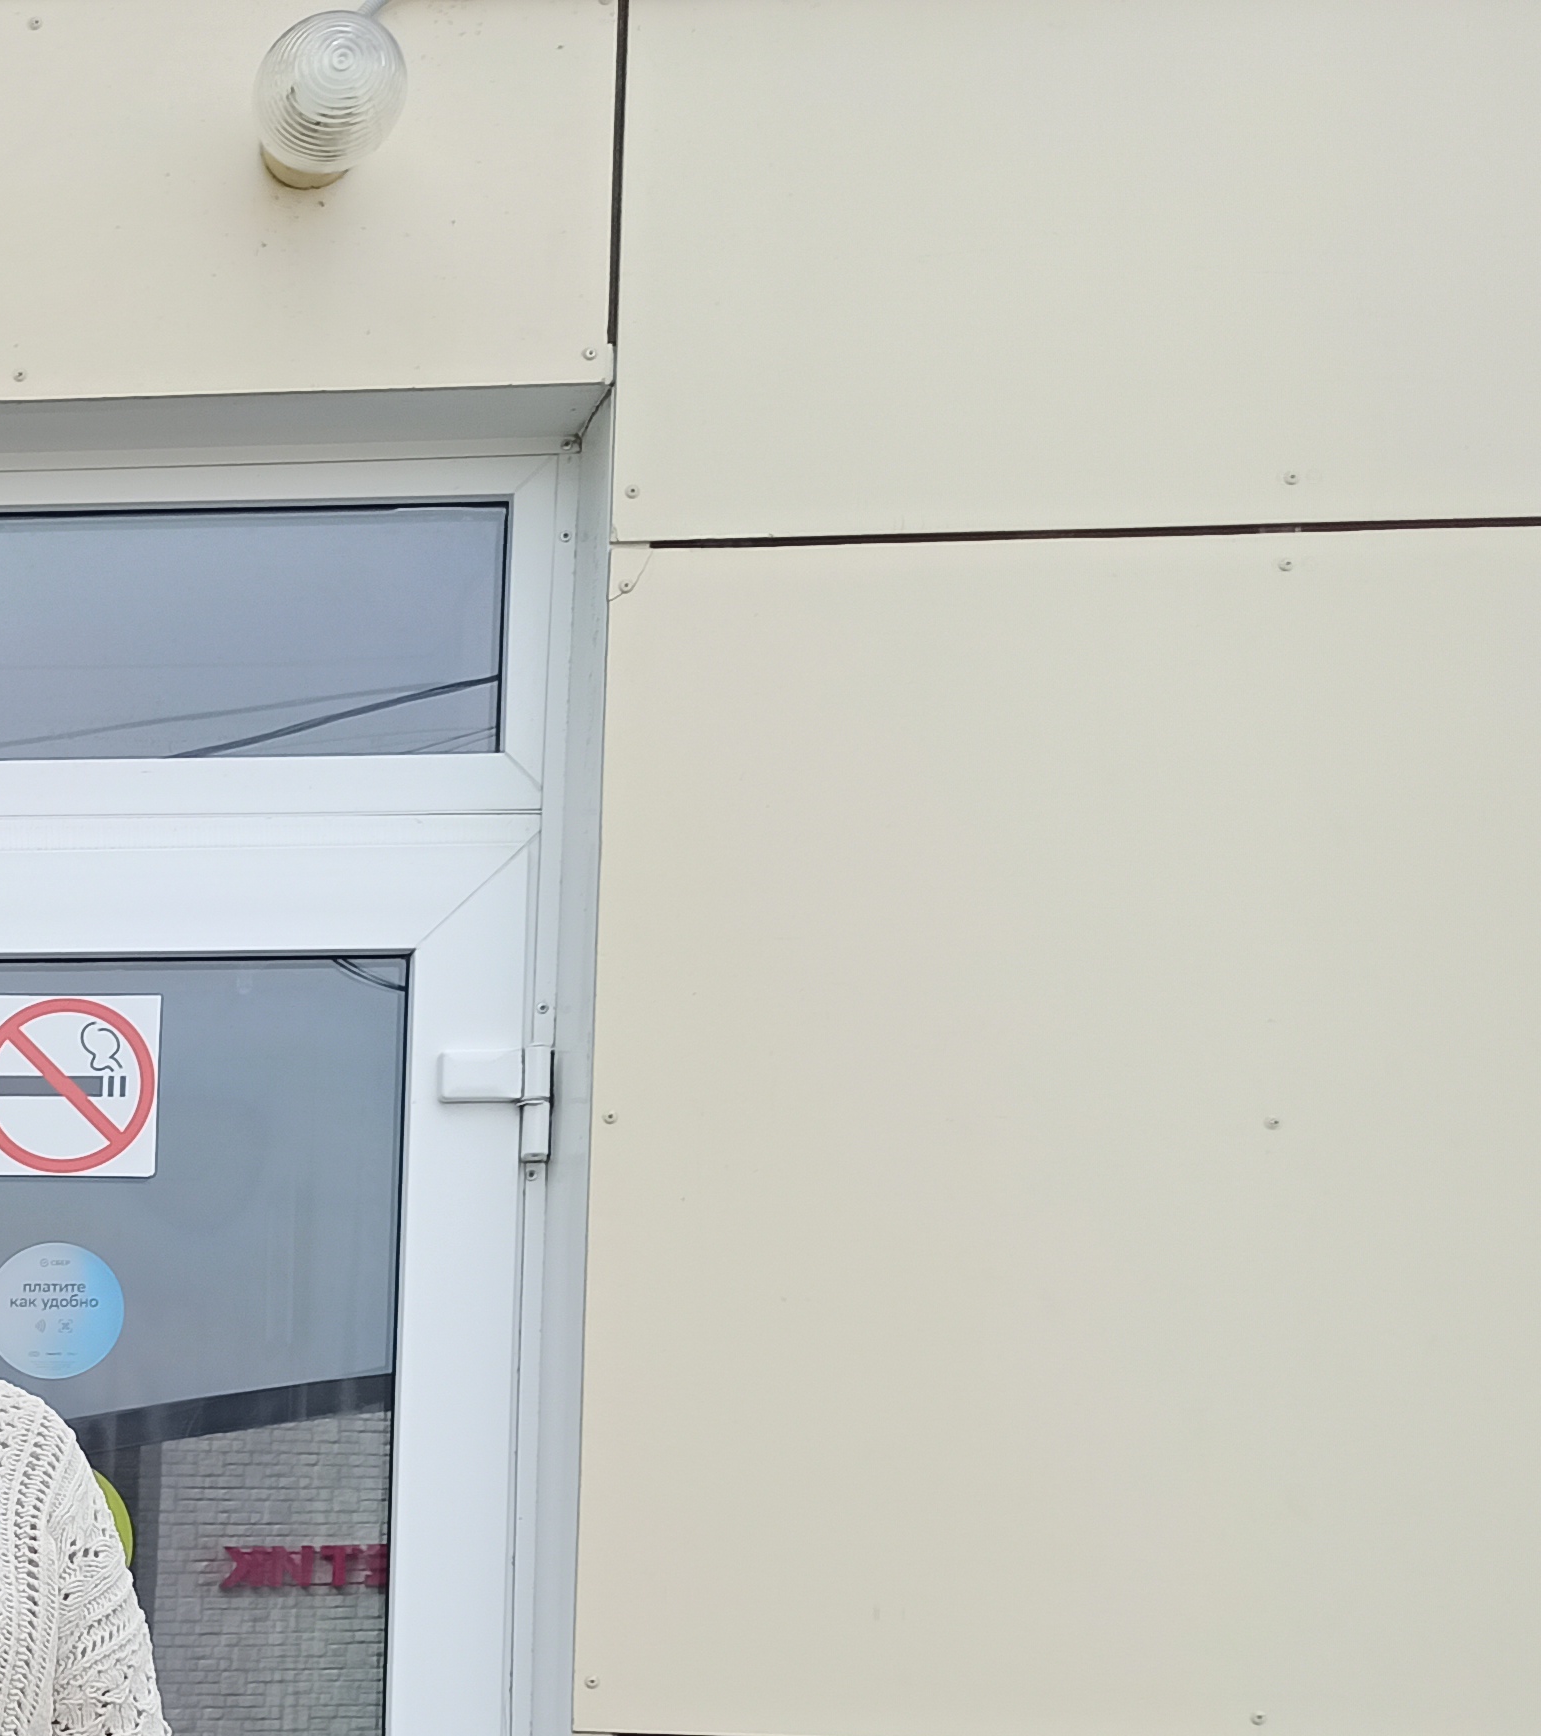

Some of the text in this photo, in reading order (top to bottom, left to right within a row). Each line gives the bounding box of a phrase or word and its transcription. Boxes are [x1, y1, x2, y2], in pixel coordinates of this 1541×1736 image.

[22, 1283, 86, 1293] платите
[9, 1294, 99, 1311] как удобно
